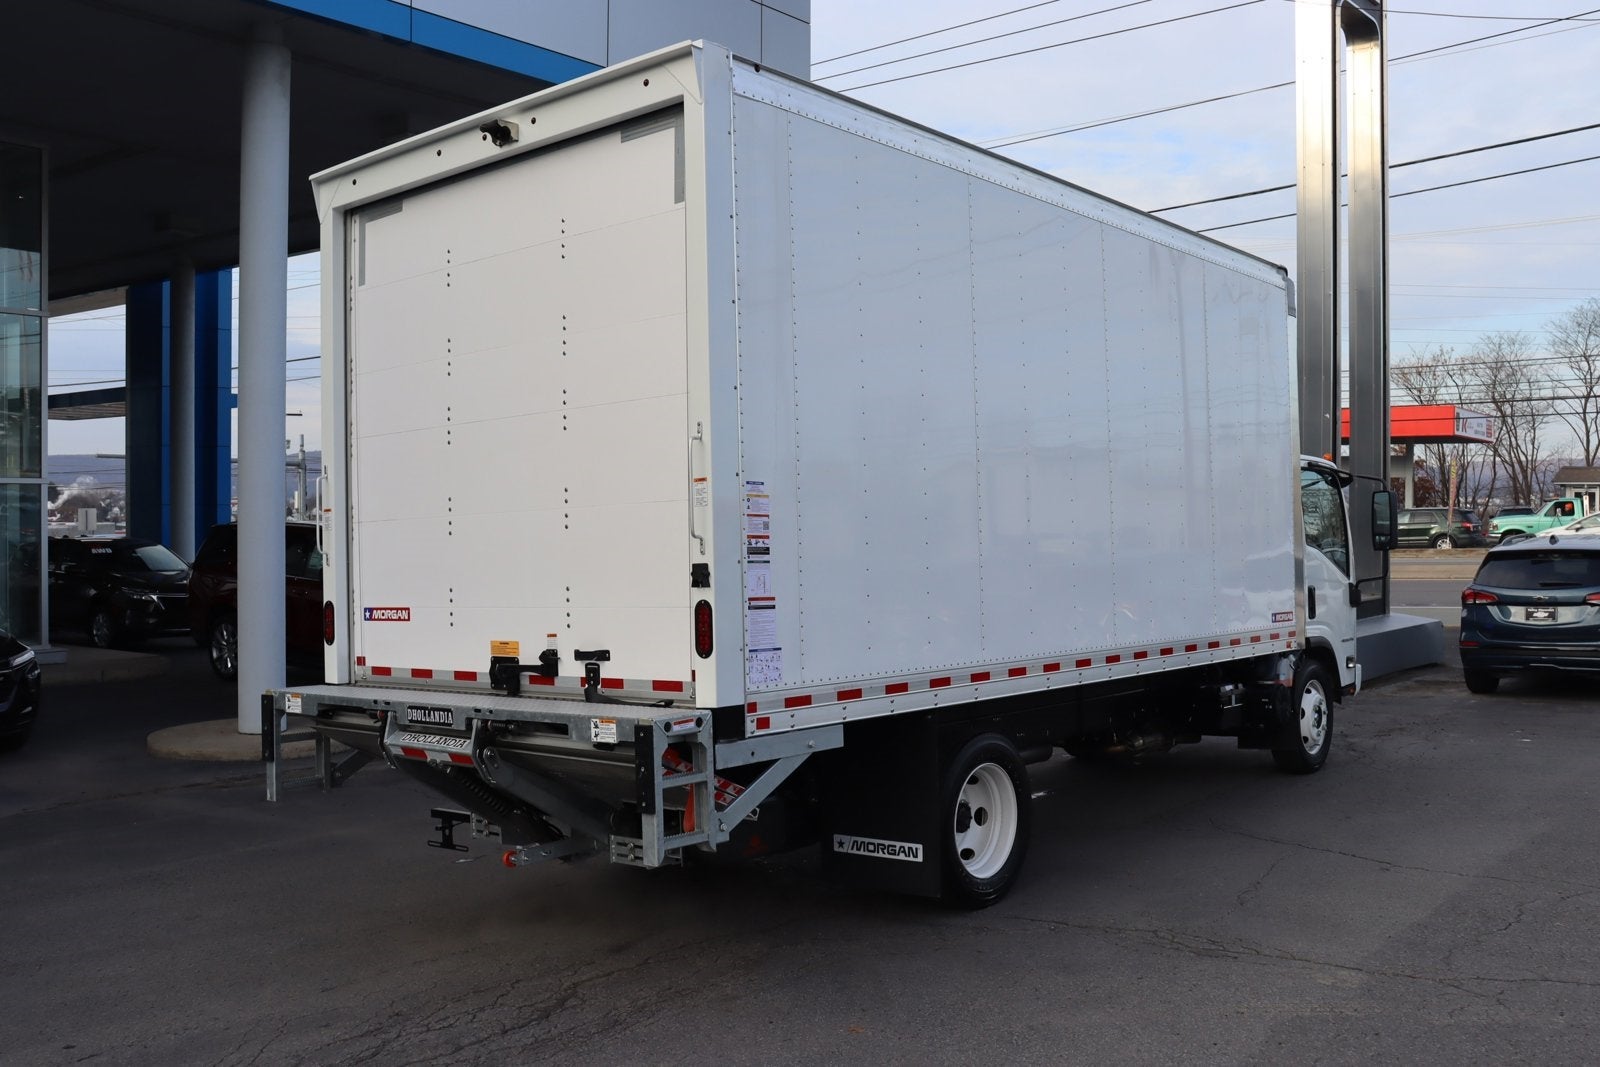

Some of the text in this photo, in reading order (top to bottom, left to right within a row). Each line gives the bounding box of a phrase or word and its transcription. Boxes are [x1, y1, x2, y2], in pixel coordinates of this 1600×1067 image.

[372, 609, 409, 620] MORGAN
[407, 708, 453, 724] DHOLLANDIA
[401, 733, 468, 749] DHOLLANDIA
[850, 839, 919, 859] MORGAN
